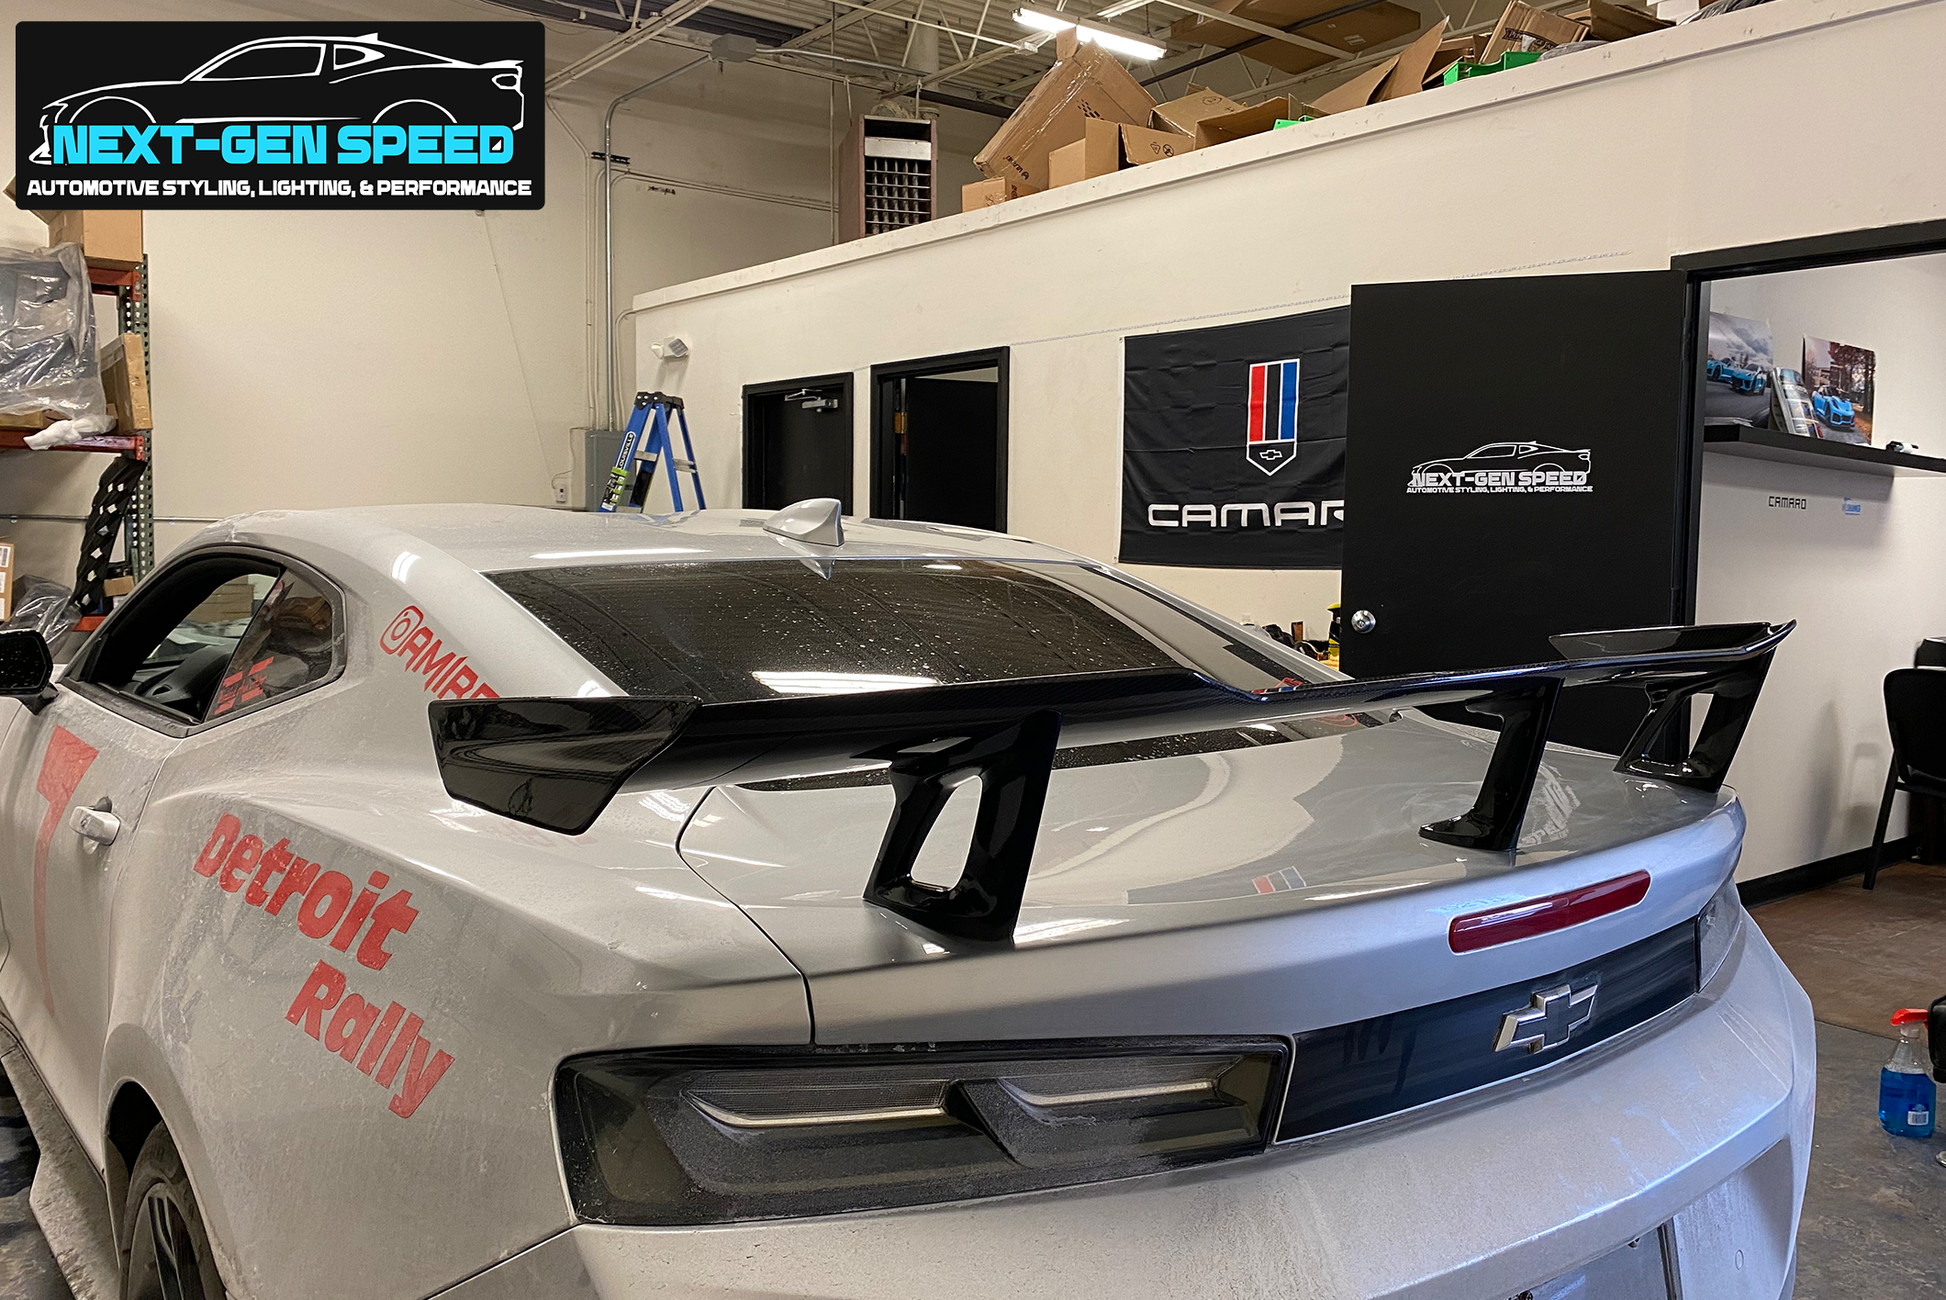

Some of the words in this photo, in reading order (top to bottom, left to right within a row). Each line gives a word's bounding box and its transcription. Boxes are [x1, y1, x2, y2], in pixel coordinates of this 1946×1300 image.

[1412, 471, 1515, 487] NEXT-GEN
[1518, 471, 1588, 487] SPEED
[1406, 486, 1455, 494] AUTOMOTIVE
[1455, 486, 1490, 494] STYLING,
[1490, 486, 1527, 494] LIGHTING,
[1533, 485, 1593, 493] PERFORMANCE
[1768, 495, 1806, 510] CAMARO
[193, 813, 419, 971] Detroit
[285, 959, 456, 1119] Rally
